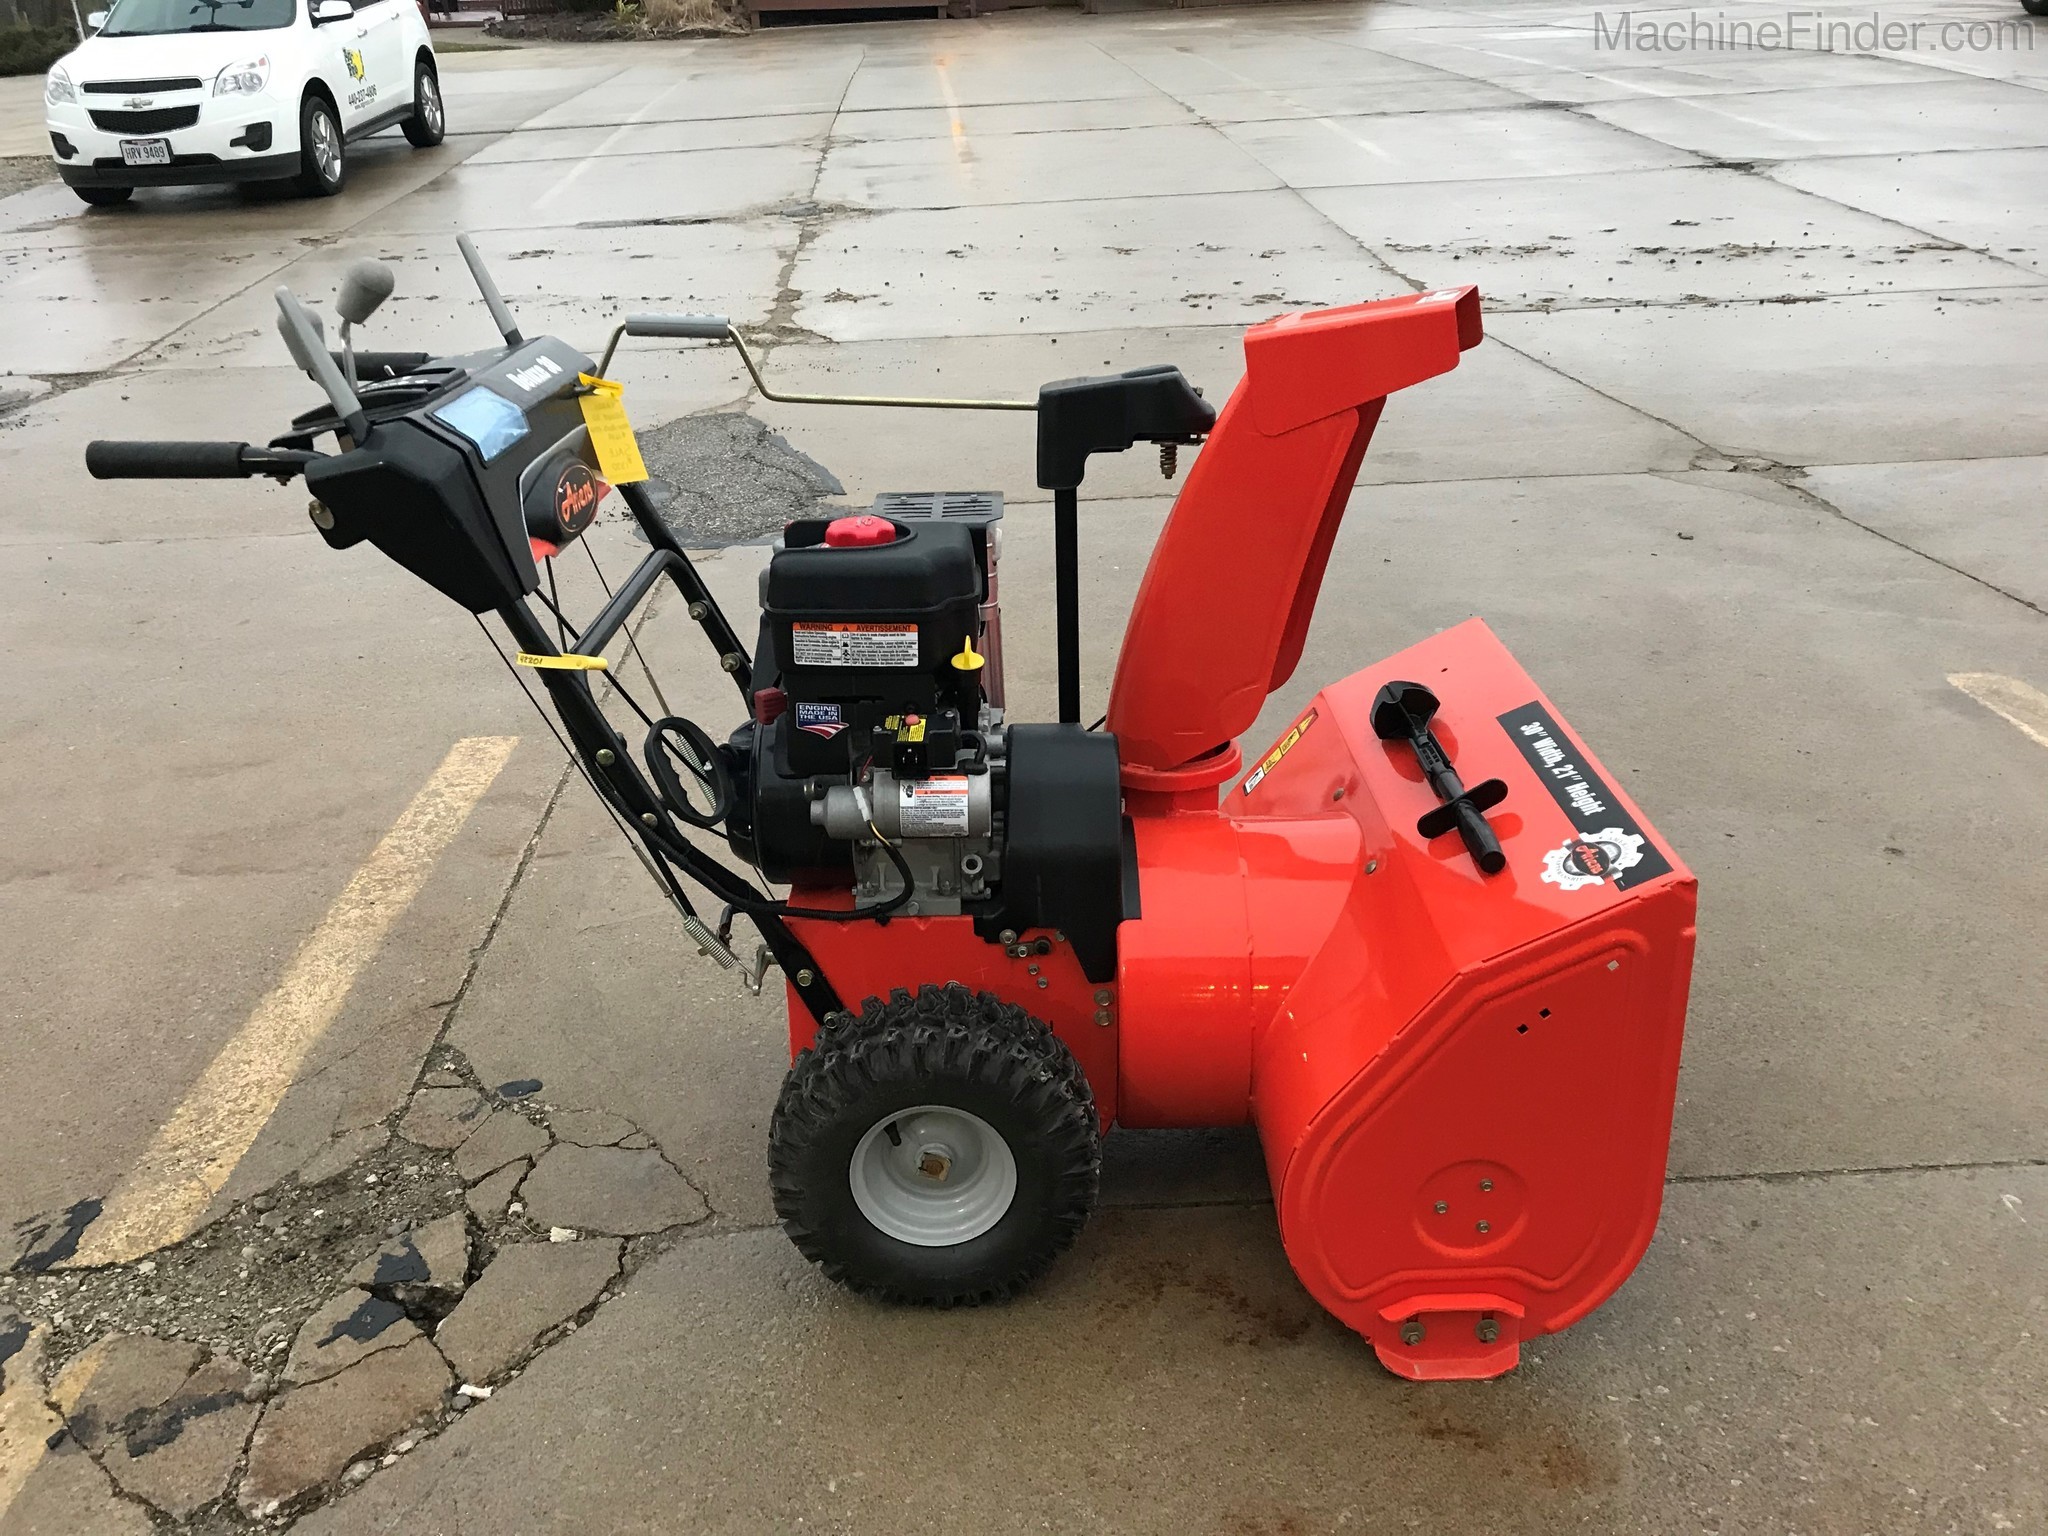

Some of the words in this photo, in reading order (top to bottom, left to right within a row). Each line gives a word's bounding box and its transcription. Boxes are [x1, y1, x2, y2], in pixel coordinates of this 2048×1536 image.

[143, 146, 166, 159] 9489
[561, 480, 594, 523] Ariens
[800, 623, 833, 631] WARNING
[799, 704, 838, 712] ENGINE
[1532, 736, 1566, 768] Width,
[1551, 764, 1583, 780] 21"
[1564, 781, 1606, 816] Height
[1575, 845, 1604, 874] Ariens
